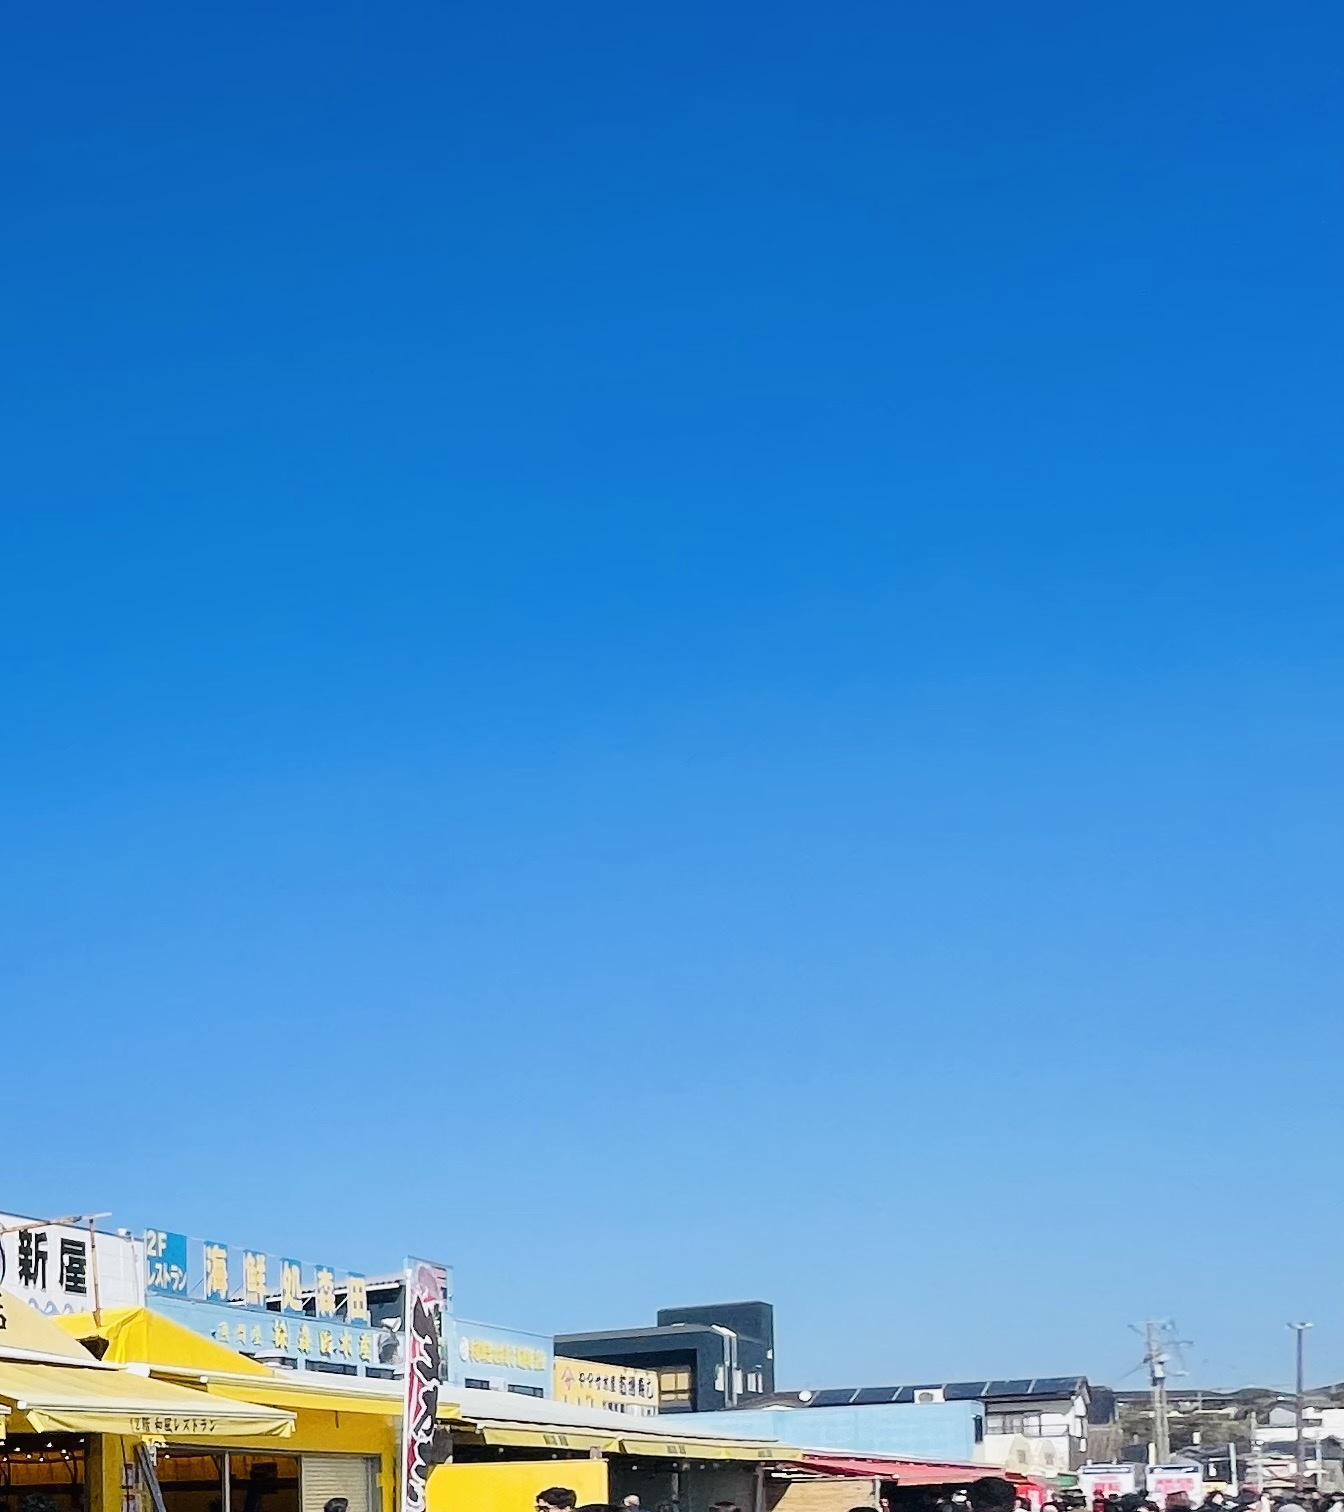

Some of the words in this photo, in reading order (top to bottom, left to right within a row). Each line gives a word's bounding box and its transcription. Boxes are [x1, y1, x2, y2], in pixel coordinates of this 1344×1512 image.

[146, 1229, 168, 1257] 2F
[17, 1229, 88, 1297] 新屋
[146, 1260, 188, 1291] レストラン
